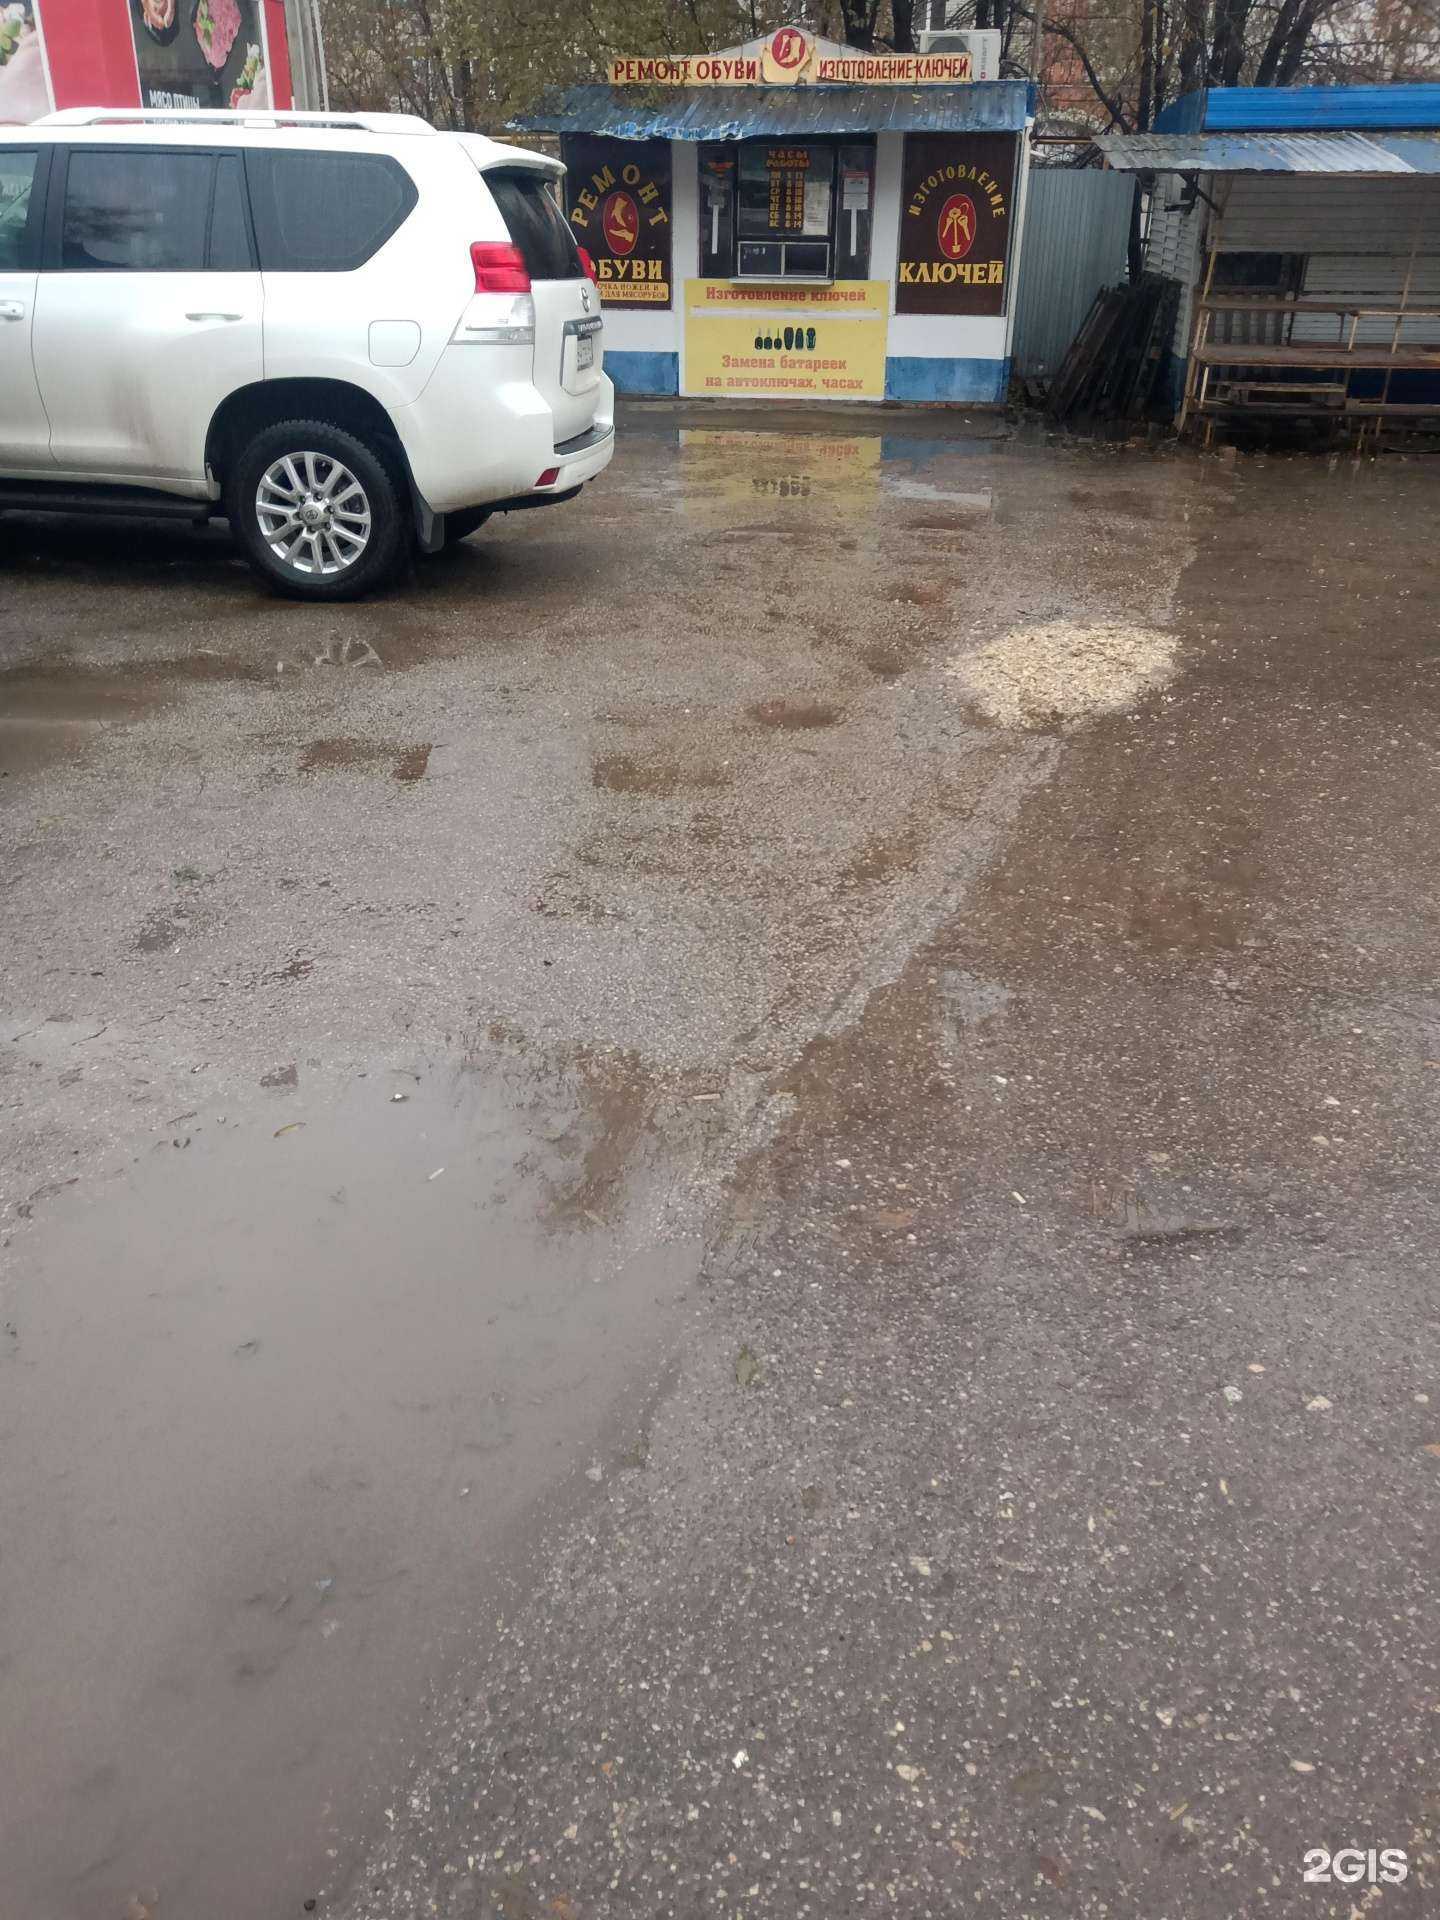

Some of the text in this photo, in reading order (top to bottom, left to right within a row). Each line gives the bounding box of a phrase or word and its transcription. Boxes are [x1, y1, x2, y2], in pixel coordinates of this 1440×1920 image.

[614, 60, 756, 80] РЕМОНТ ОБУВИ
[820, 56, 968, 79] ИЗГОТОВЛЕНИЕ КЛЮЧЕЙ
[149, 90, 172, 109] МЯСО
[571, 164, 669, 228] РЕМОНТ
[908, 164, 1005, 218] ИЗГОТОВЛЕНИЕ
[899, 260, 1004, 284] КЛЮЧЕЙ
[706, 286, 866, 301] Изготовление ключей
[722, 354, 847, 373] Замена батареек
[705, 376, 863, 390] на автоключах, часах
